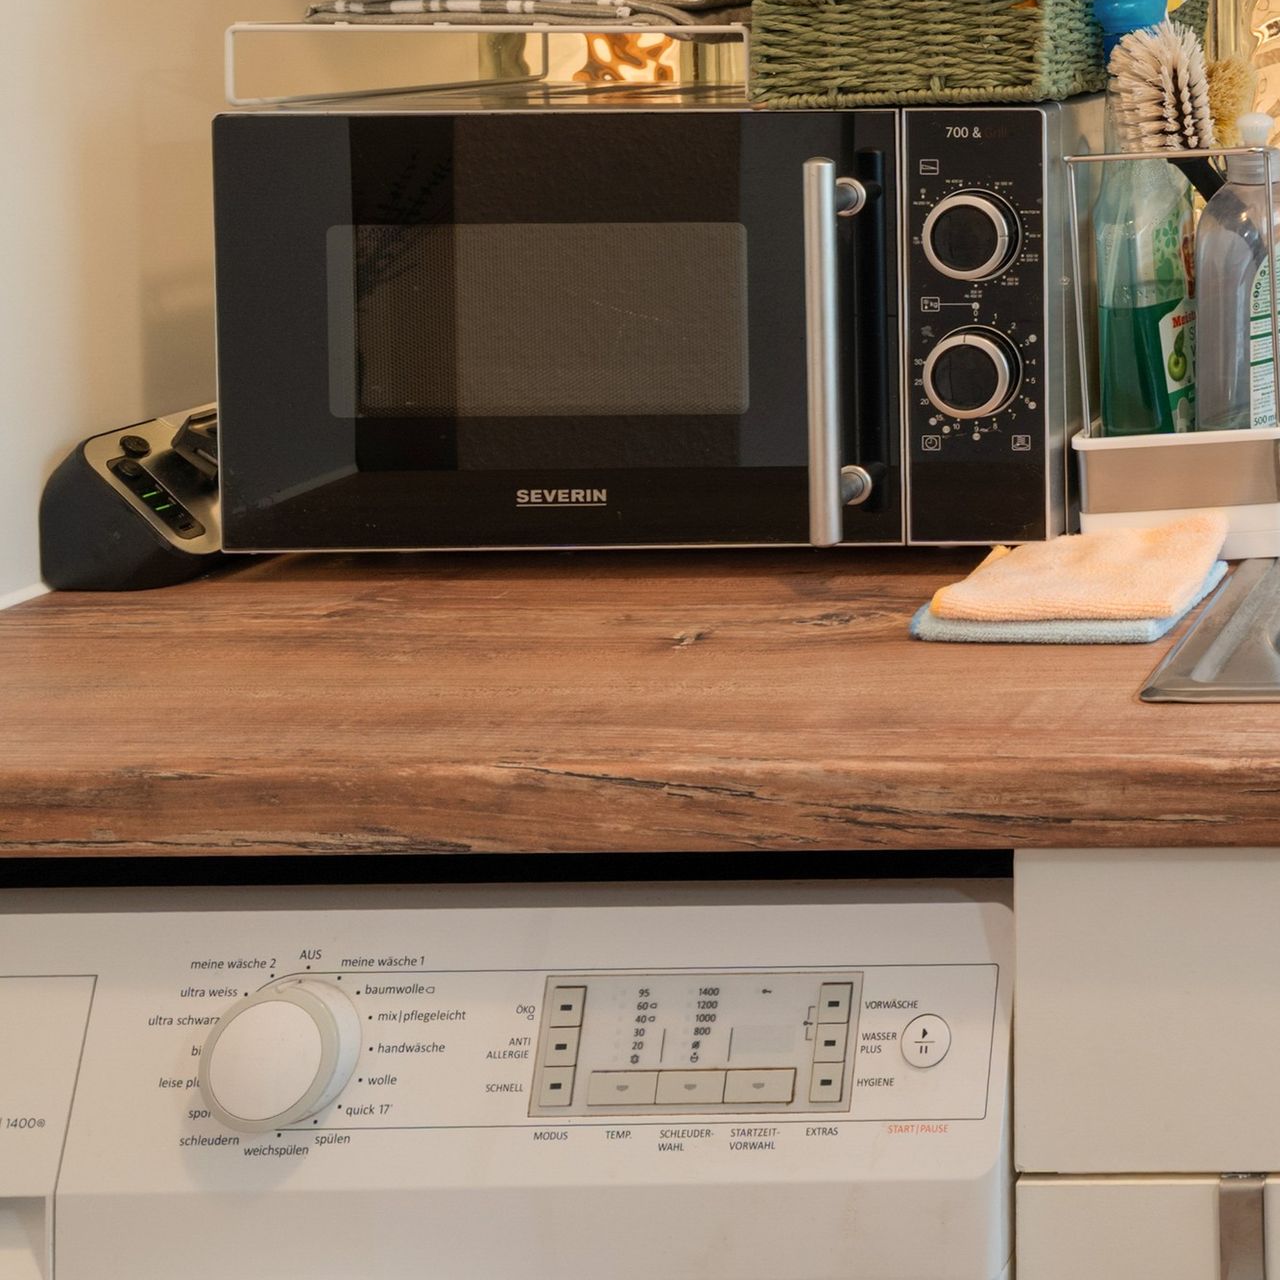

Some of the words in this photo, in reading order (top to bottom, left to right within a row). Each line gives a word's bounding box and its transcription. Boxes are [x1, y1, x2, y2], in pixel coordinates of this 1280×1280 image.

[945, 126, 969, 138] 700
[972, 126, 982, 138] &
[952, 422, 961, 430] 10
[516, 489, 607, 503] SEVERIN
[299, 949, 322, 960] AUS
[190, 959, 225, 970] meine
[227, 958, 267, 969] wäsche
[270, 958, 277, 969] 2
[341, 957, 375, 967] meine
[378, 956, 418, 967] wäsche
[420, 956, 425, 966] 1
[180, 987, 205, 997] ultra
[209, 987, 238, 997] weiss
[365, 984, 425, 995] baumwolle
[638, 988, 650, 998] 95
[698, 987, 720, 996] 1400
[515, 1003, 536, 1014] ÖKO
[636, 1002, 649, 1011] 60
[697, 1001, 718, 1009] 1200
[865, 999, 919, 1009] VORWÄSCHE
[147, 1016, 173, 1026] ultra
[635, 1014, 647, 1023] 40
[695, 1013, 716, 1022] 1000
[634, 1028, 645, 1037] 30
[693, 1027, 711, 1036] 800
[861, 1032, 897, 1041] WASSER
[508, 1037, 531, 1046] ANTI
[631, 1041, 644, 1050] 20
[377, 1042, 446, 1054] handwäsche
[860, 1044, 882, 1054] PLUS
[486, 1050, 529, 1059] ALLERGIE
[158, 1077, 183, 1088] leise
[368, 1074, 397, 1085] wolle
[856, 1077, 895, 1087] HYGIENE
[485, 1083, 524, 1093] SCHNELL
[345, 1104, 375, 1117] quick
[533, 1131, 568, 1141] MODUS
[605, 1130, 633, 1140] TEMP.
[659, 1129, 714, 1139] SCHLEUDER-
[730, 1128, 781, 1138] STARTZEIT-
[805, 1127, 839, 1137] EXTRAS
[179, 1134, 240, 1146] schleudern
[314, 1134, 351, 1146] spülen
[657, 1142, 684, 1152] WAHL
[729, 1141, 776, 1151] VORWAHL
[243, 1145, 309, 1158] weichspülen
